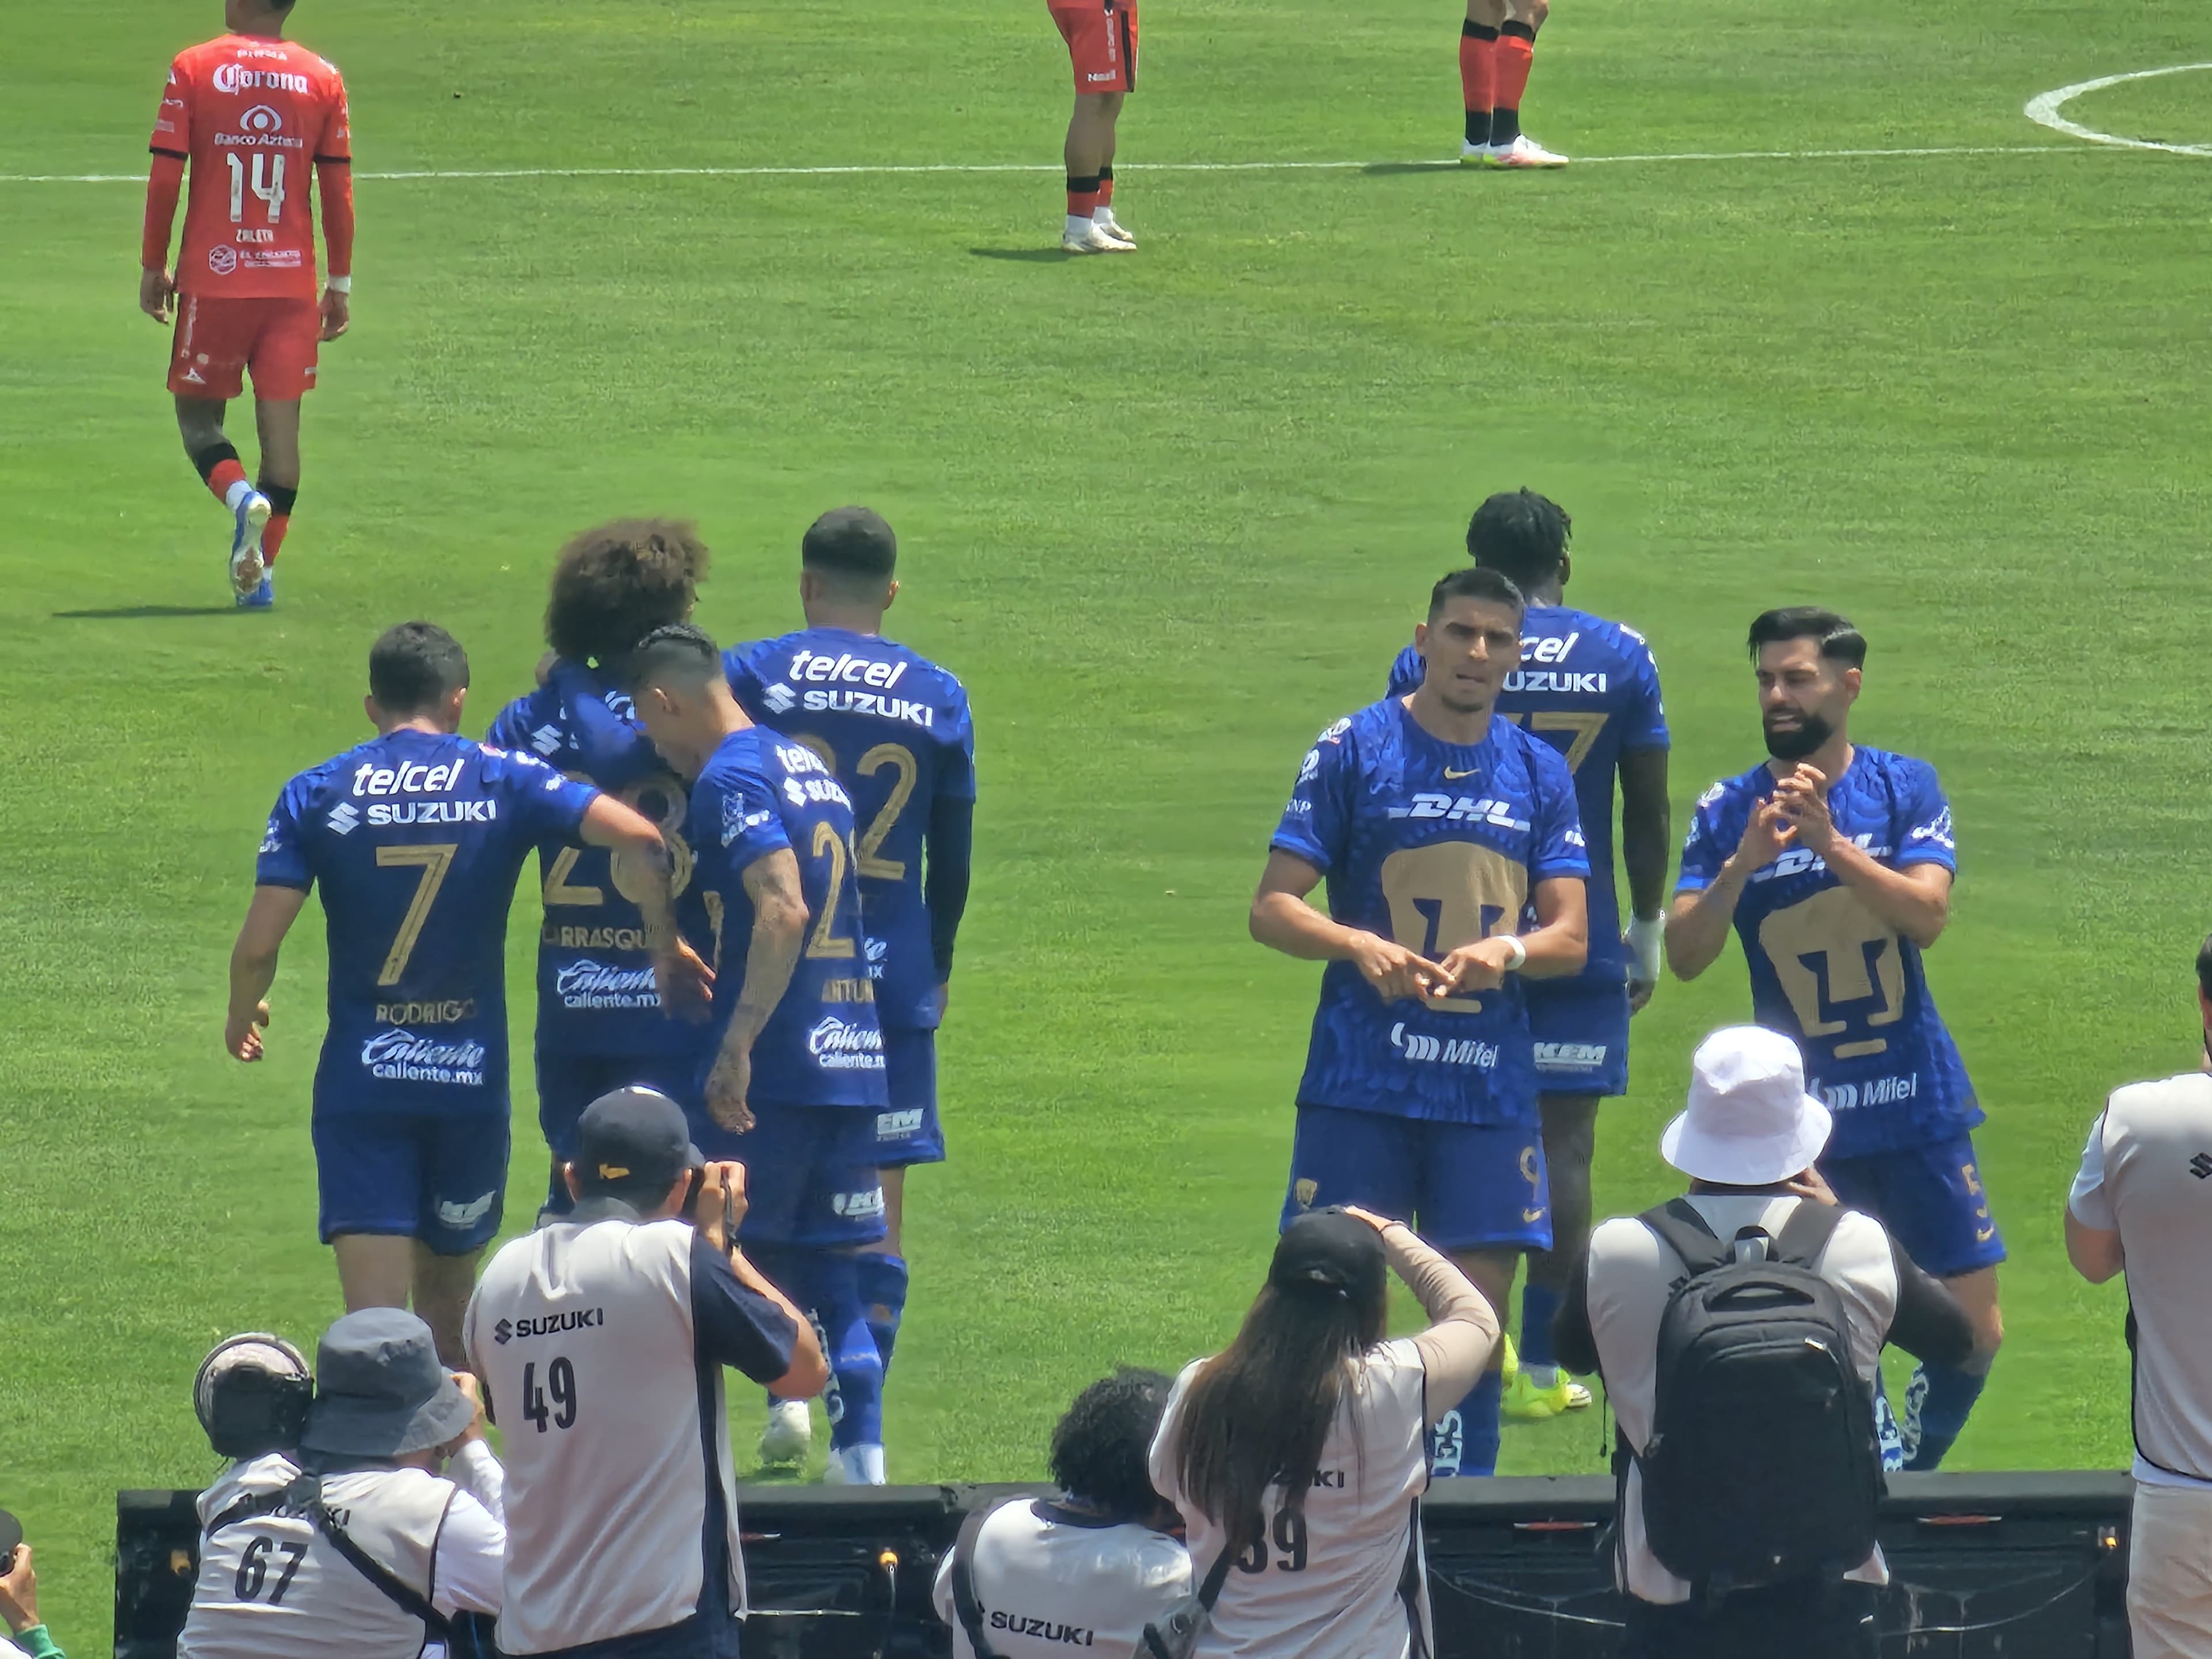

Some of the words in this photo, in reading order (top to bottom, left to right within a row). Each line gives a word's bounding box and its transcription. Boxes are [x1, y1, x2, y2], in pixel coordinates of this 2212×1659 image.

[213, 63, 308, 96] Corona
[227, 153, 286, 224] 14
[789, 650, 907, 689] telcel
[803, 690, 933, 728] SUZUKI
[352, 758, 465, 797] telcel
[368, 800, 497, 825] SUZUKI
[1411, 793, 1515, 828] DHL
[376, 843, 459, 986] 7
[361, 1028, 485, 1068] Caliente
[516, 1307, 604, 1338] SUZUKI
[522, 1356, 576, 1433] 49
[234, 1536, 309, 1605] 67
[990, 1612, 1094, 1646] SUZUKI
